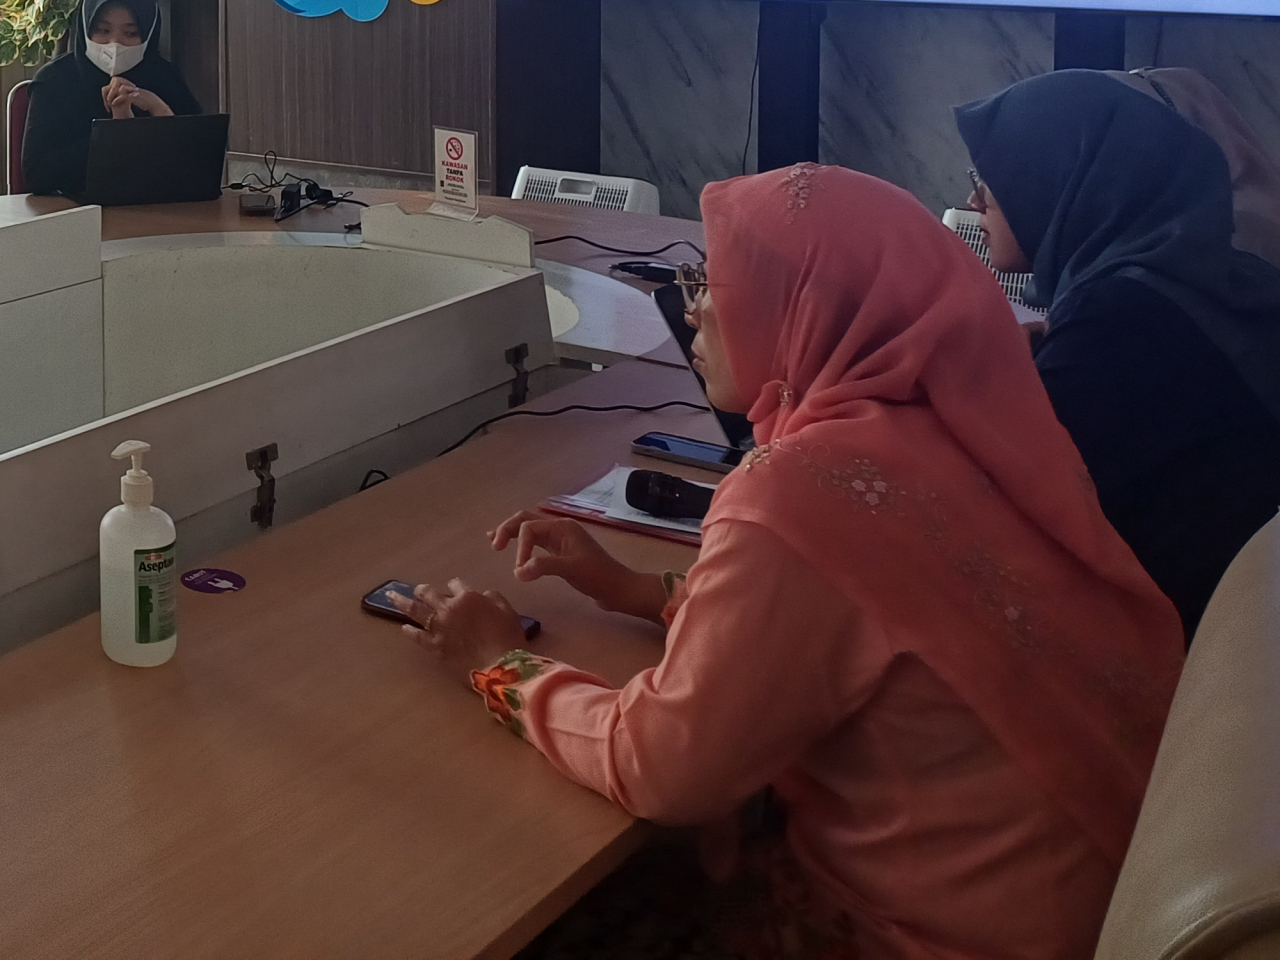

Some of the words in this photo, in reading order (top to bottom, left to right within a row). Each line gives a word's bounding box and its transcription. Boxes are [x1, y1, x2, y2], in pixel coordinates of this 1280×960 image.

[441, 160, 468, 170] KAWASAN
[446, 168, 464, 176] TANPA
[445, 174, 464, 183] ROKOK
